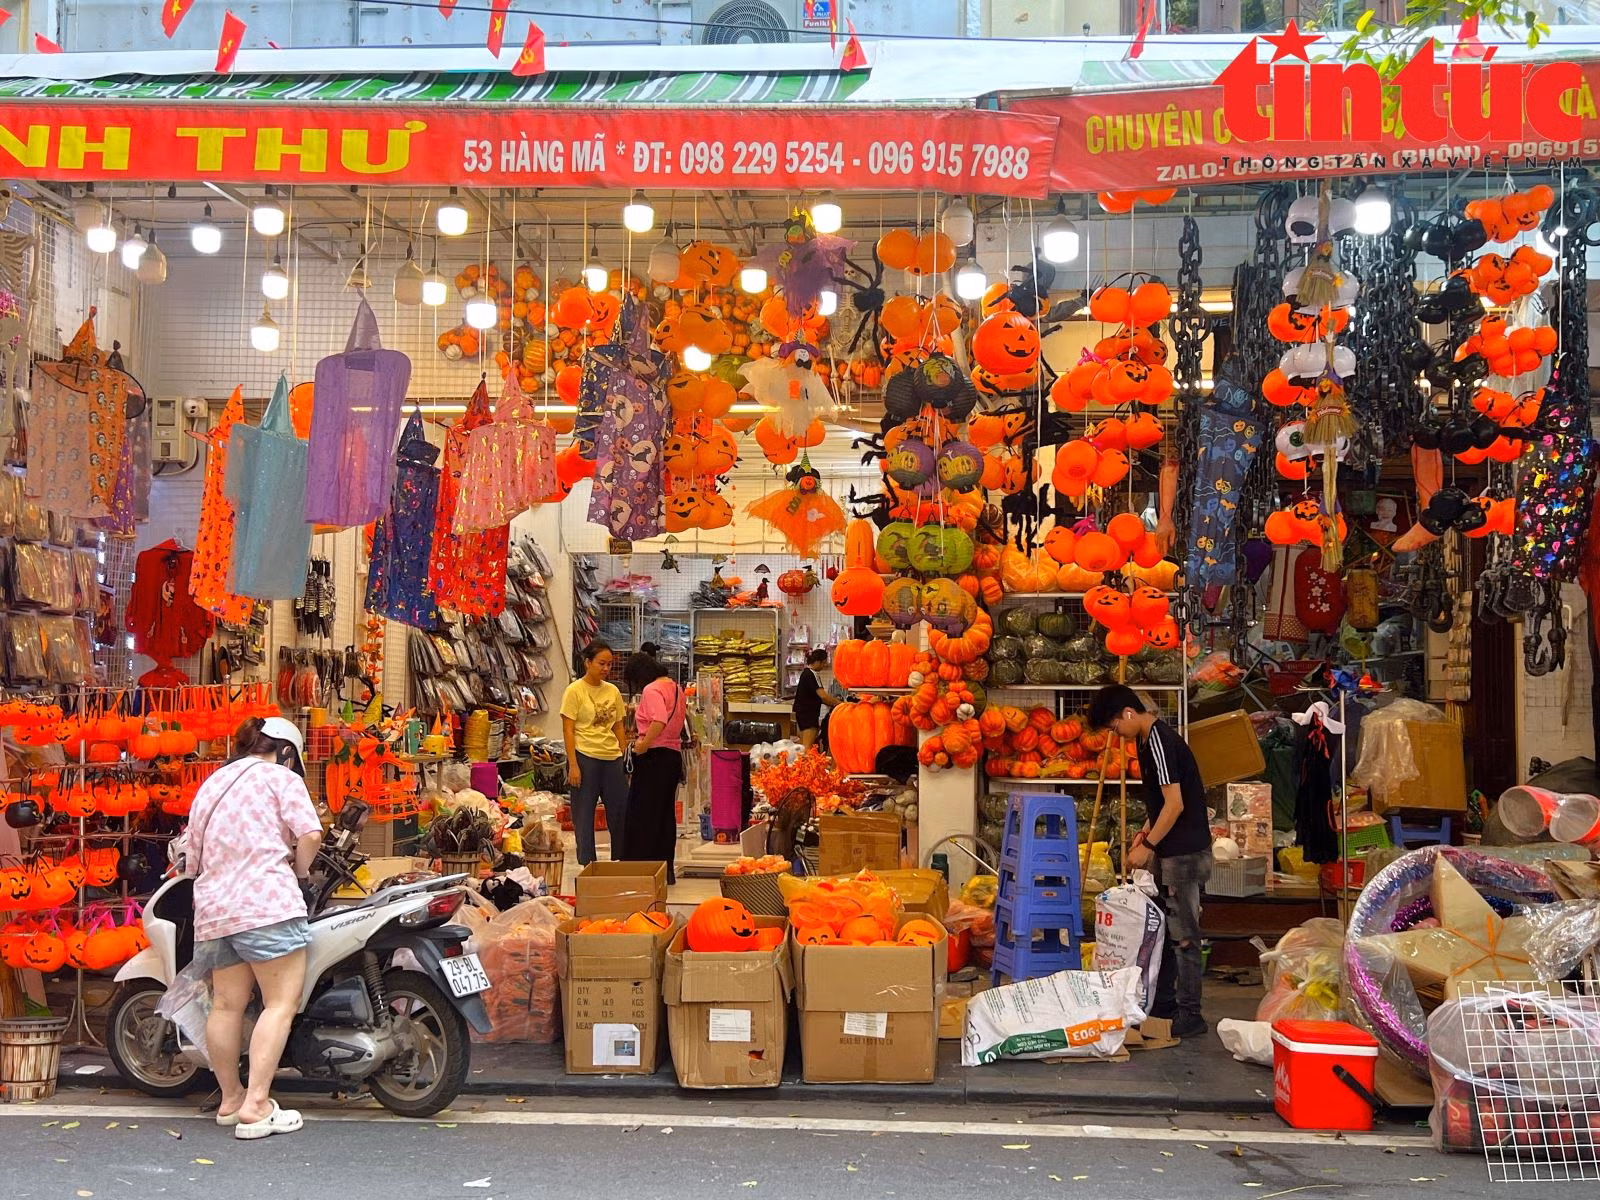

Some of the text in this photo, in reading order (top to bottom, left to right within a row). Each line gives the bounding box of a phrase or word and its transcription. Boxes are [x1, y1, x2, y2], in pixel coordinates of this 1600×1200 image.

[1086, 103, 1204, 154] CHUYÊN
[176, 120, 428, 174] THƯ
[463, 140, 493, 173] 53
[501, 131, 565, 173] HÀNG
[571, 132, 606, 173] MÃ
[633, 141, 672, 174] ĐT:
[679, 141, 724, 174] 098
[731, 141, 777, 174] 229
[785, 141, 845, 174] 5254
[868, 141, 914, 174] 096
[921, 140, 964, 177] 915
[970, 144, 1030, 180] 7988
[1156, 161, 1225, 182] ZALO:
[1508, 138, 1600, 158] 096915
[330, 911, 377, 930] VISION
[447, 956, 478, 977] 29-BL
[452, 971, 489, 994] 047.75
[631, 986, 644, 995] PCS
[631, 1010, 645, 1018] KGS
